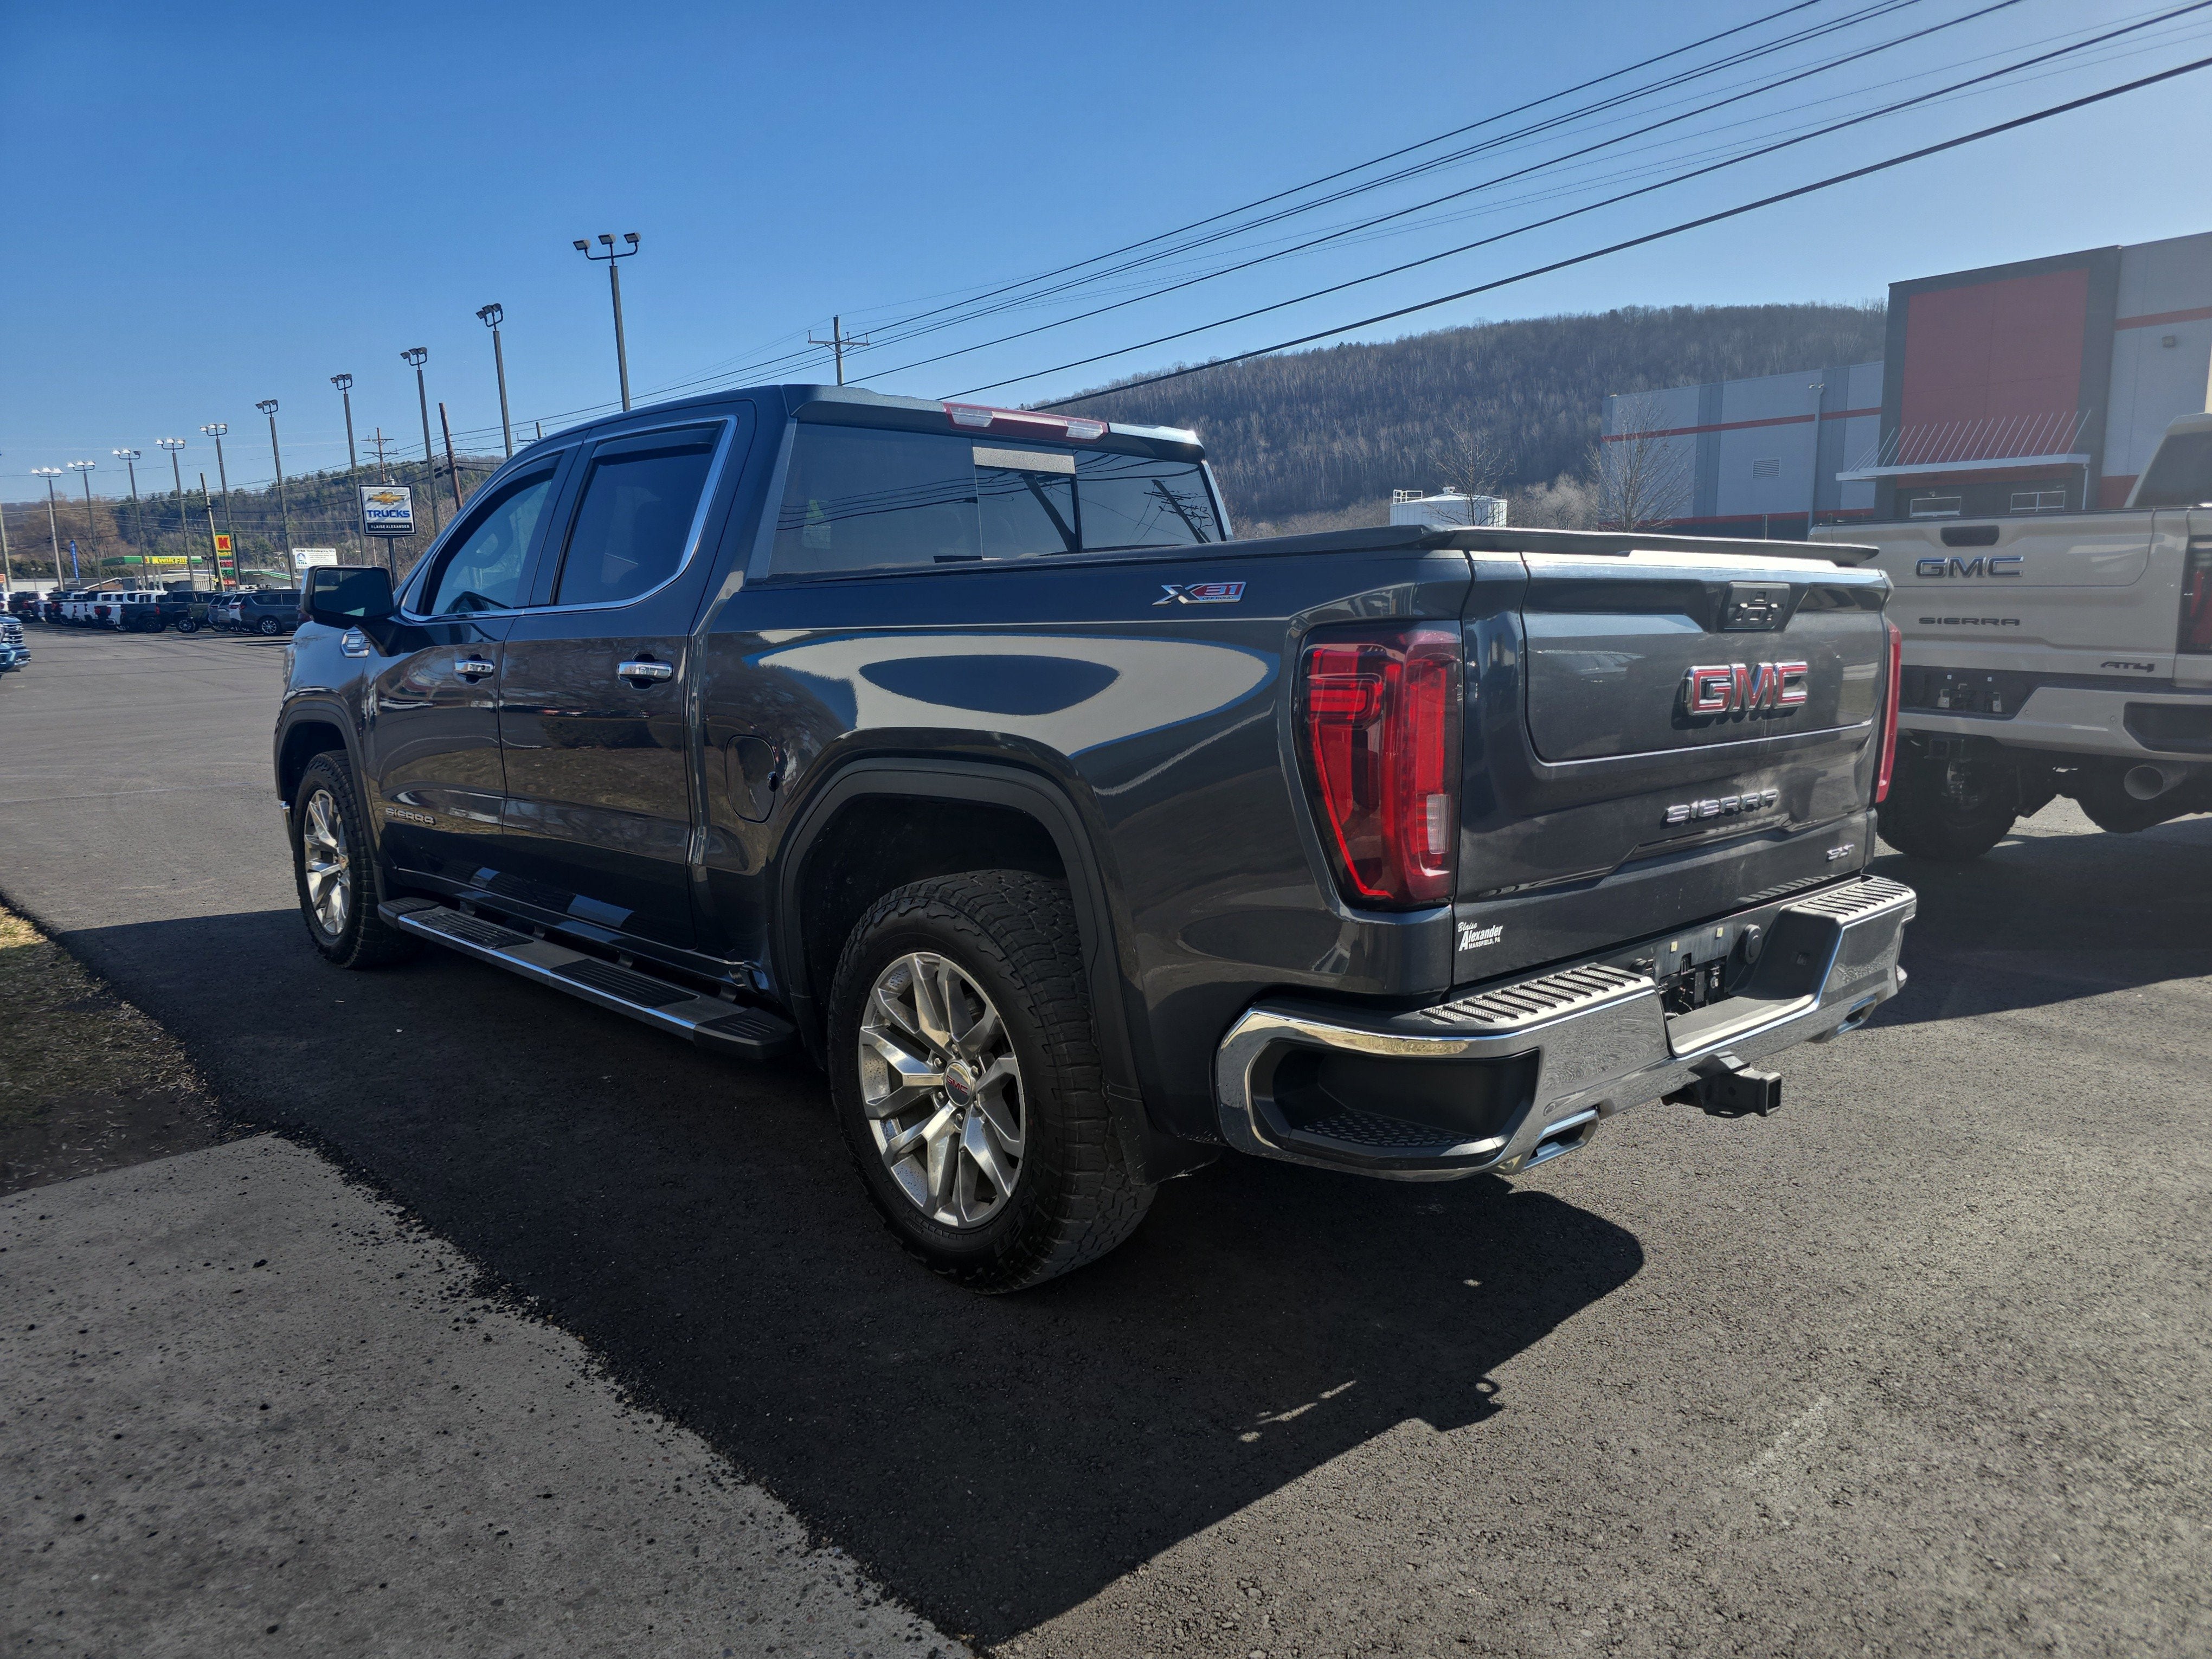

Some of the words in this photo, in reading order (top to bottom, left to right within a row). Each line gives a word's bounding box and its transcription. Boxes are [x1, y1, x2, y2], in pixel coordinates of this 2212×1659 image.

[366, 510, 410, 518] TRUCKS
[218, 537, 230, 549] K
[1915, 556, 2024, 578] GMC
[1152, 582, 1246, 606] X31
[1918, 617, 2021, 626] SIERRA
[2100, 661, 2155, 673] AT4
[1686, 661, 1808, 716] GMC
[1667, 788, 1779, 823] SIERRA
[385, 807, 435, 825] SIERRA
[1458, 922, 1477, 933] Blaise
[1458, 925, 1503, 951] Alexander
[1468, 938, 1494, 949] MANSFIELD,
[946, 1075, 968, 1095] GMC
